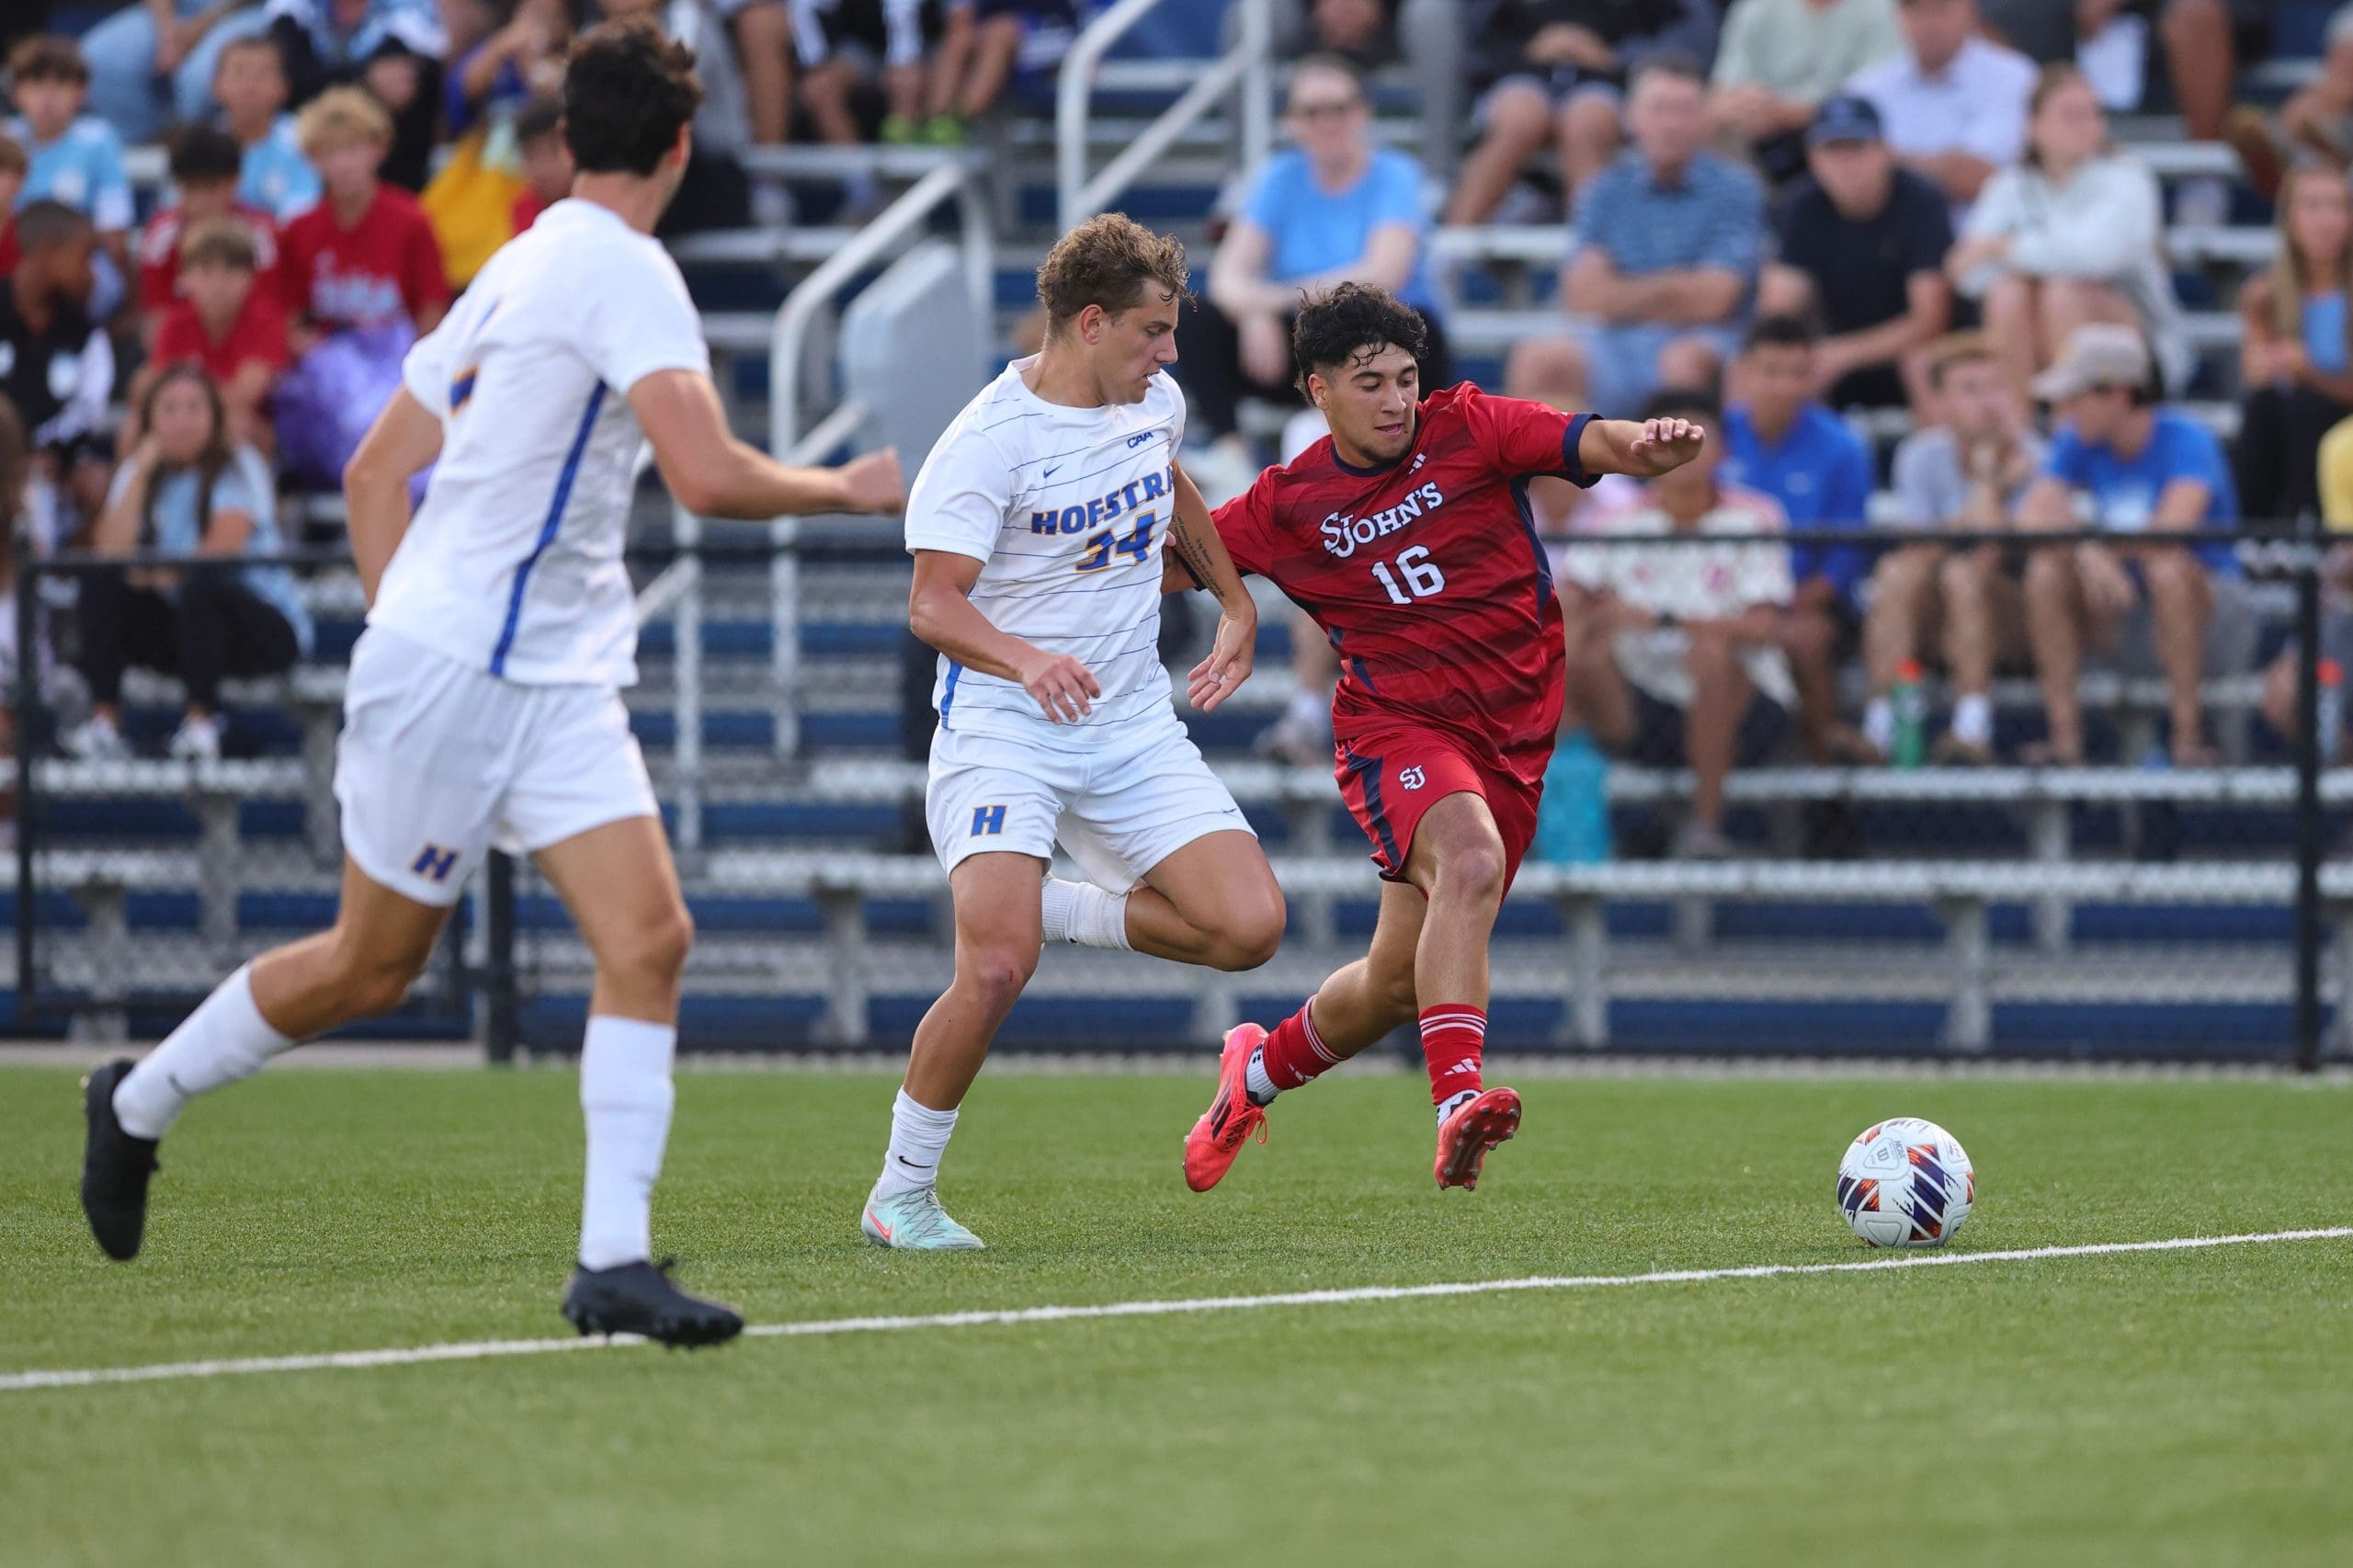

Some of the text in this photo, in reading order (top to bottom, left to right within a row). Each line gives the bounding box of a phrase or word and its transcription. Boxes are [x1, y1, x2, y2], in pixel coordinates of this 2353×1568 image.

[1127, 431, 1154, 449] CAA
[1370, 544, 1446, 605] 16
[970, 804, 1008, 838] H
[410, 844, 460, 883] H
